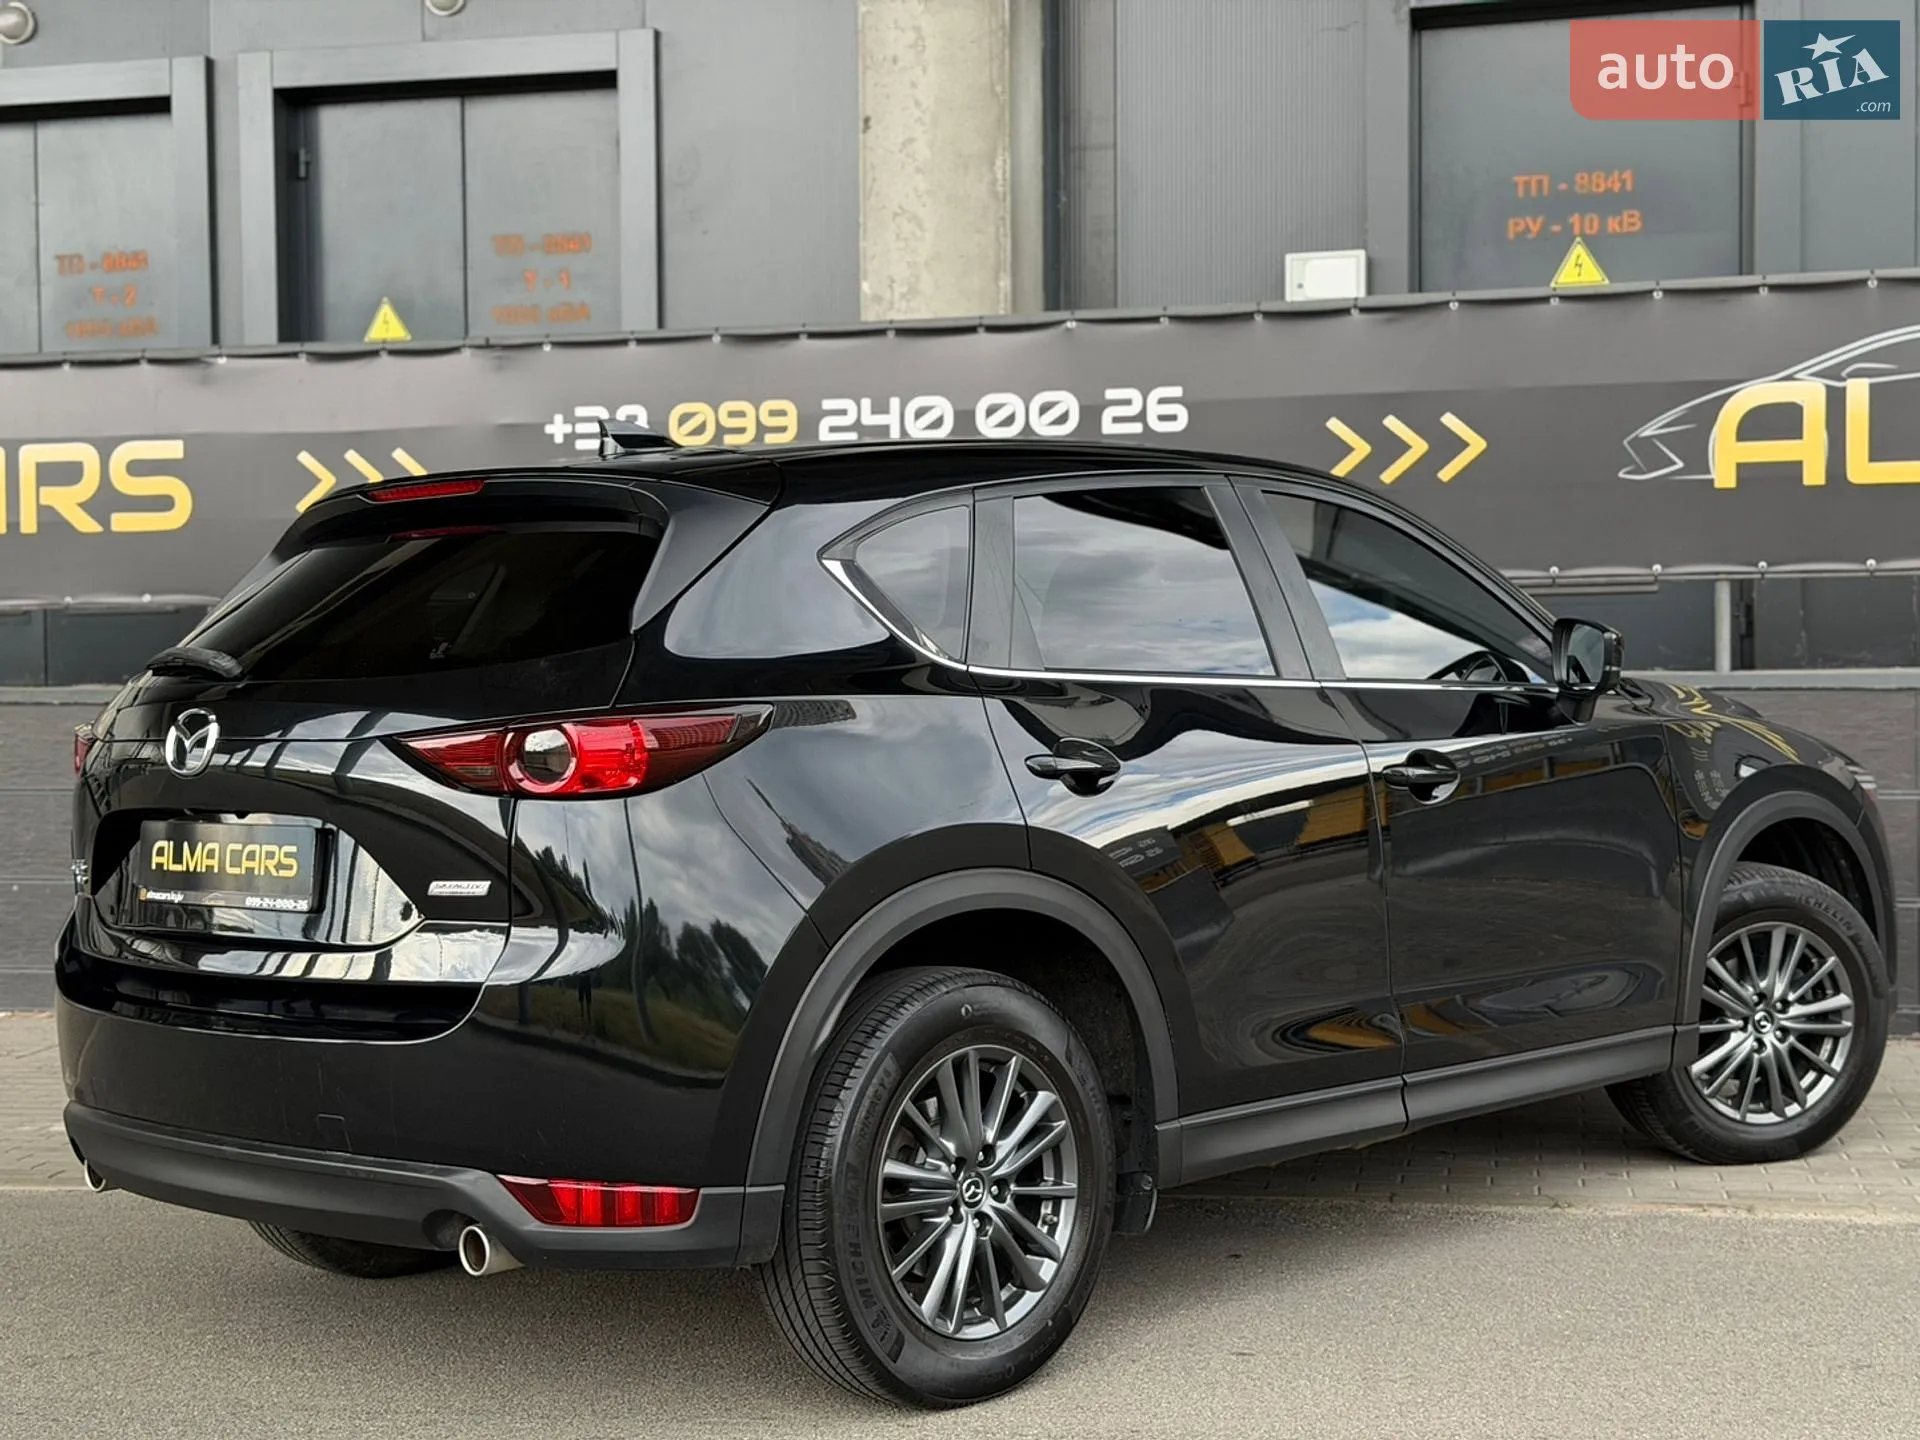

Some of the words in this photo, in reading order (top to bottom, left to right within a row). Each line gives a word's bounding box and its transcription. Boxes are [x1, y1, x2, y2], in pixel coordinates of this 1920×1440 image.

[1512, 173, 1550, 198] ТП
[1568, 212, 1600, 236] 10
[668, 399, 798, 447] 099
[818, 395, 954, 442] 240
[975, 391, 1080, 438] 00
[1101, 386, 1189, 434] 26
[0, 439, 194, 535] RS
[151, 840, 219, 873] ALMA
[225, 842, 298, 878] CARS
